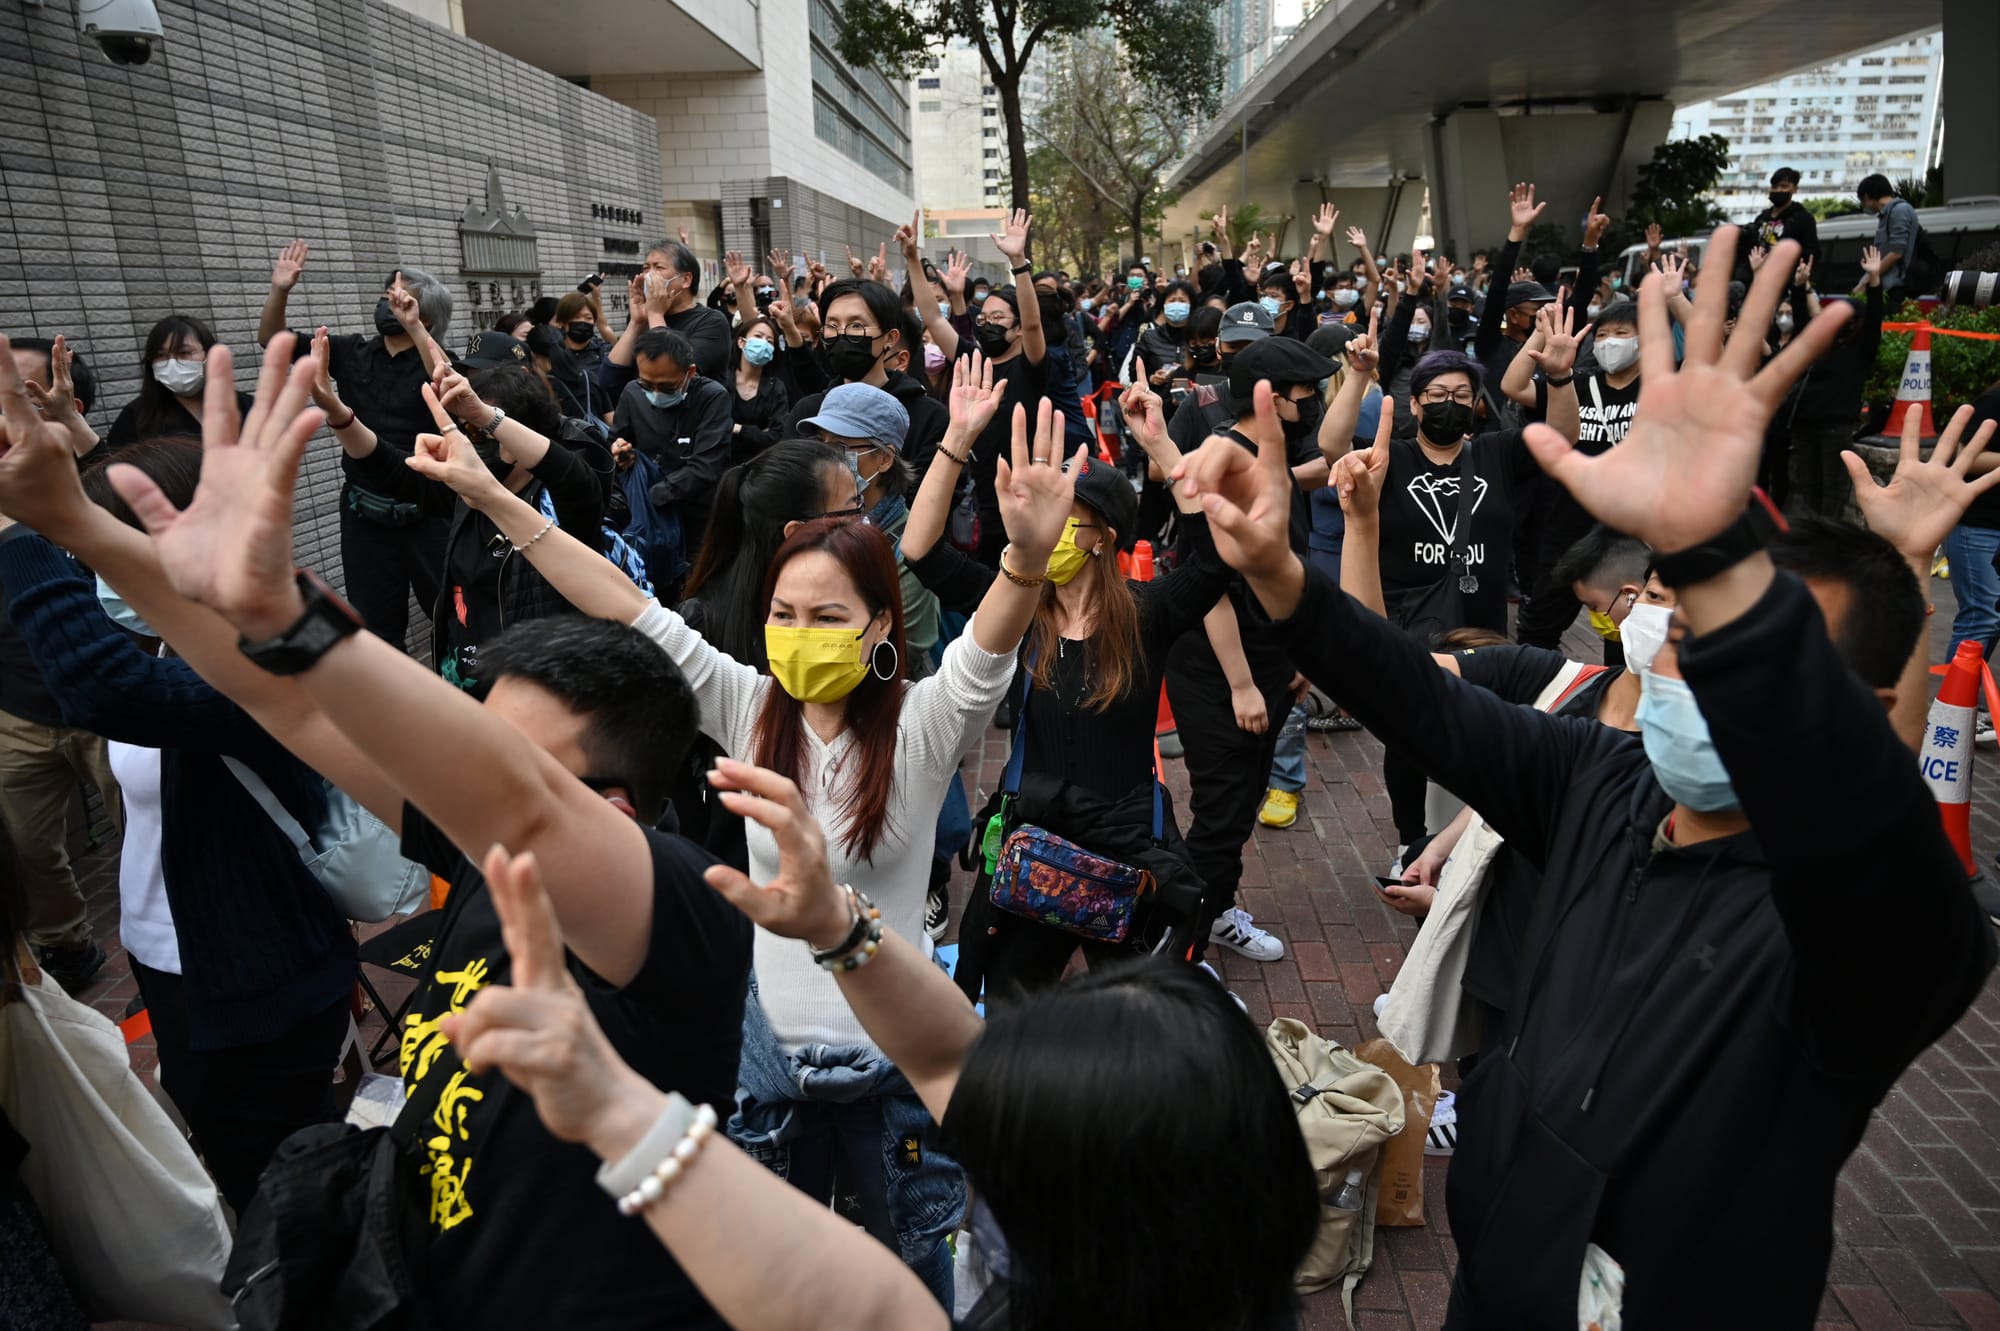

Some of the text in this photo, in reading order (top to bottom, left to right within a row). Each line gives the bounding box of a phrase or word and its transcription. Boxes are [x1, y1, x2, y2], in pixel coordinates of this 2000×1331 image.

[1902, 378, 1931, 390] POLIC
[1619, 401, 1639, 418] AN
[1579, 422, 1605, 442] GHT
[1414, 542, 1484, 565] FOR OU
[1928, 723, 1960, 748] 察
[1921, 756, 1959, 782] ICE
